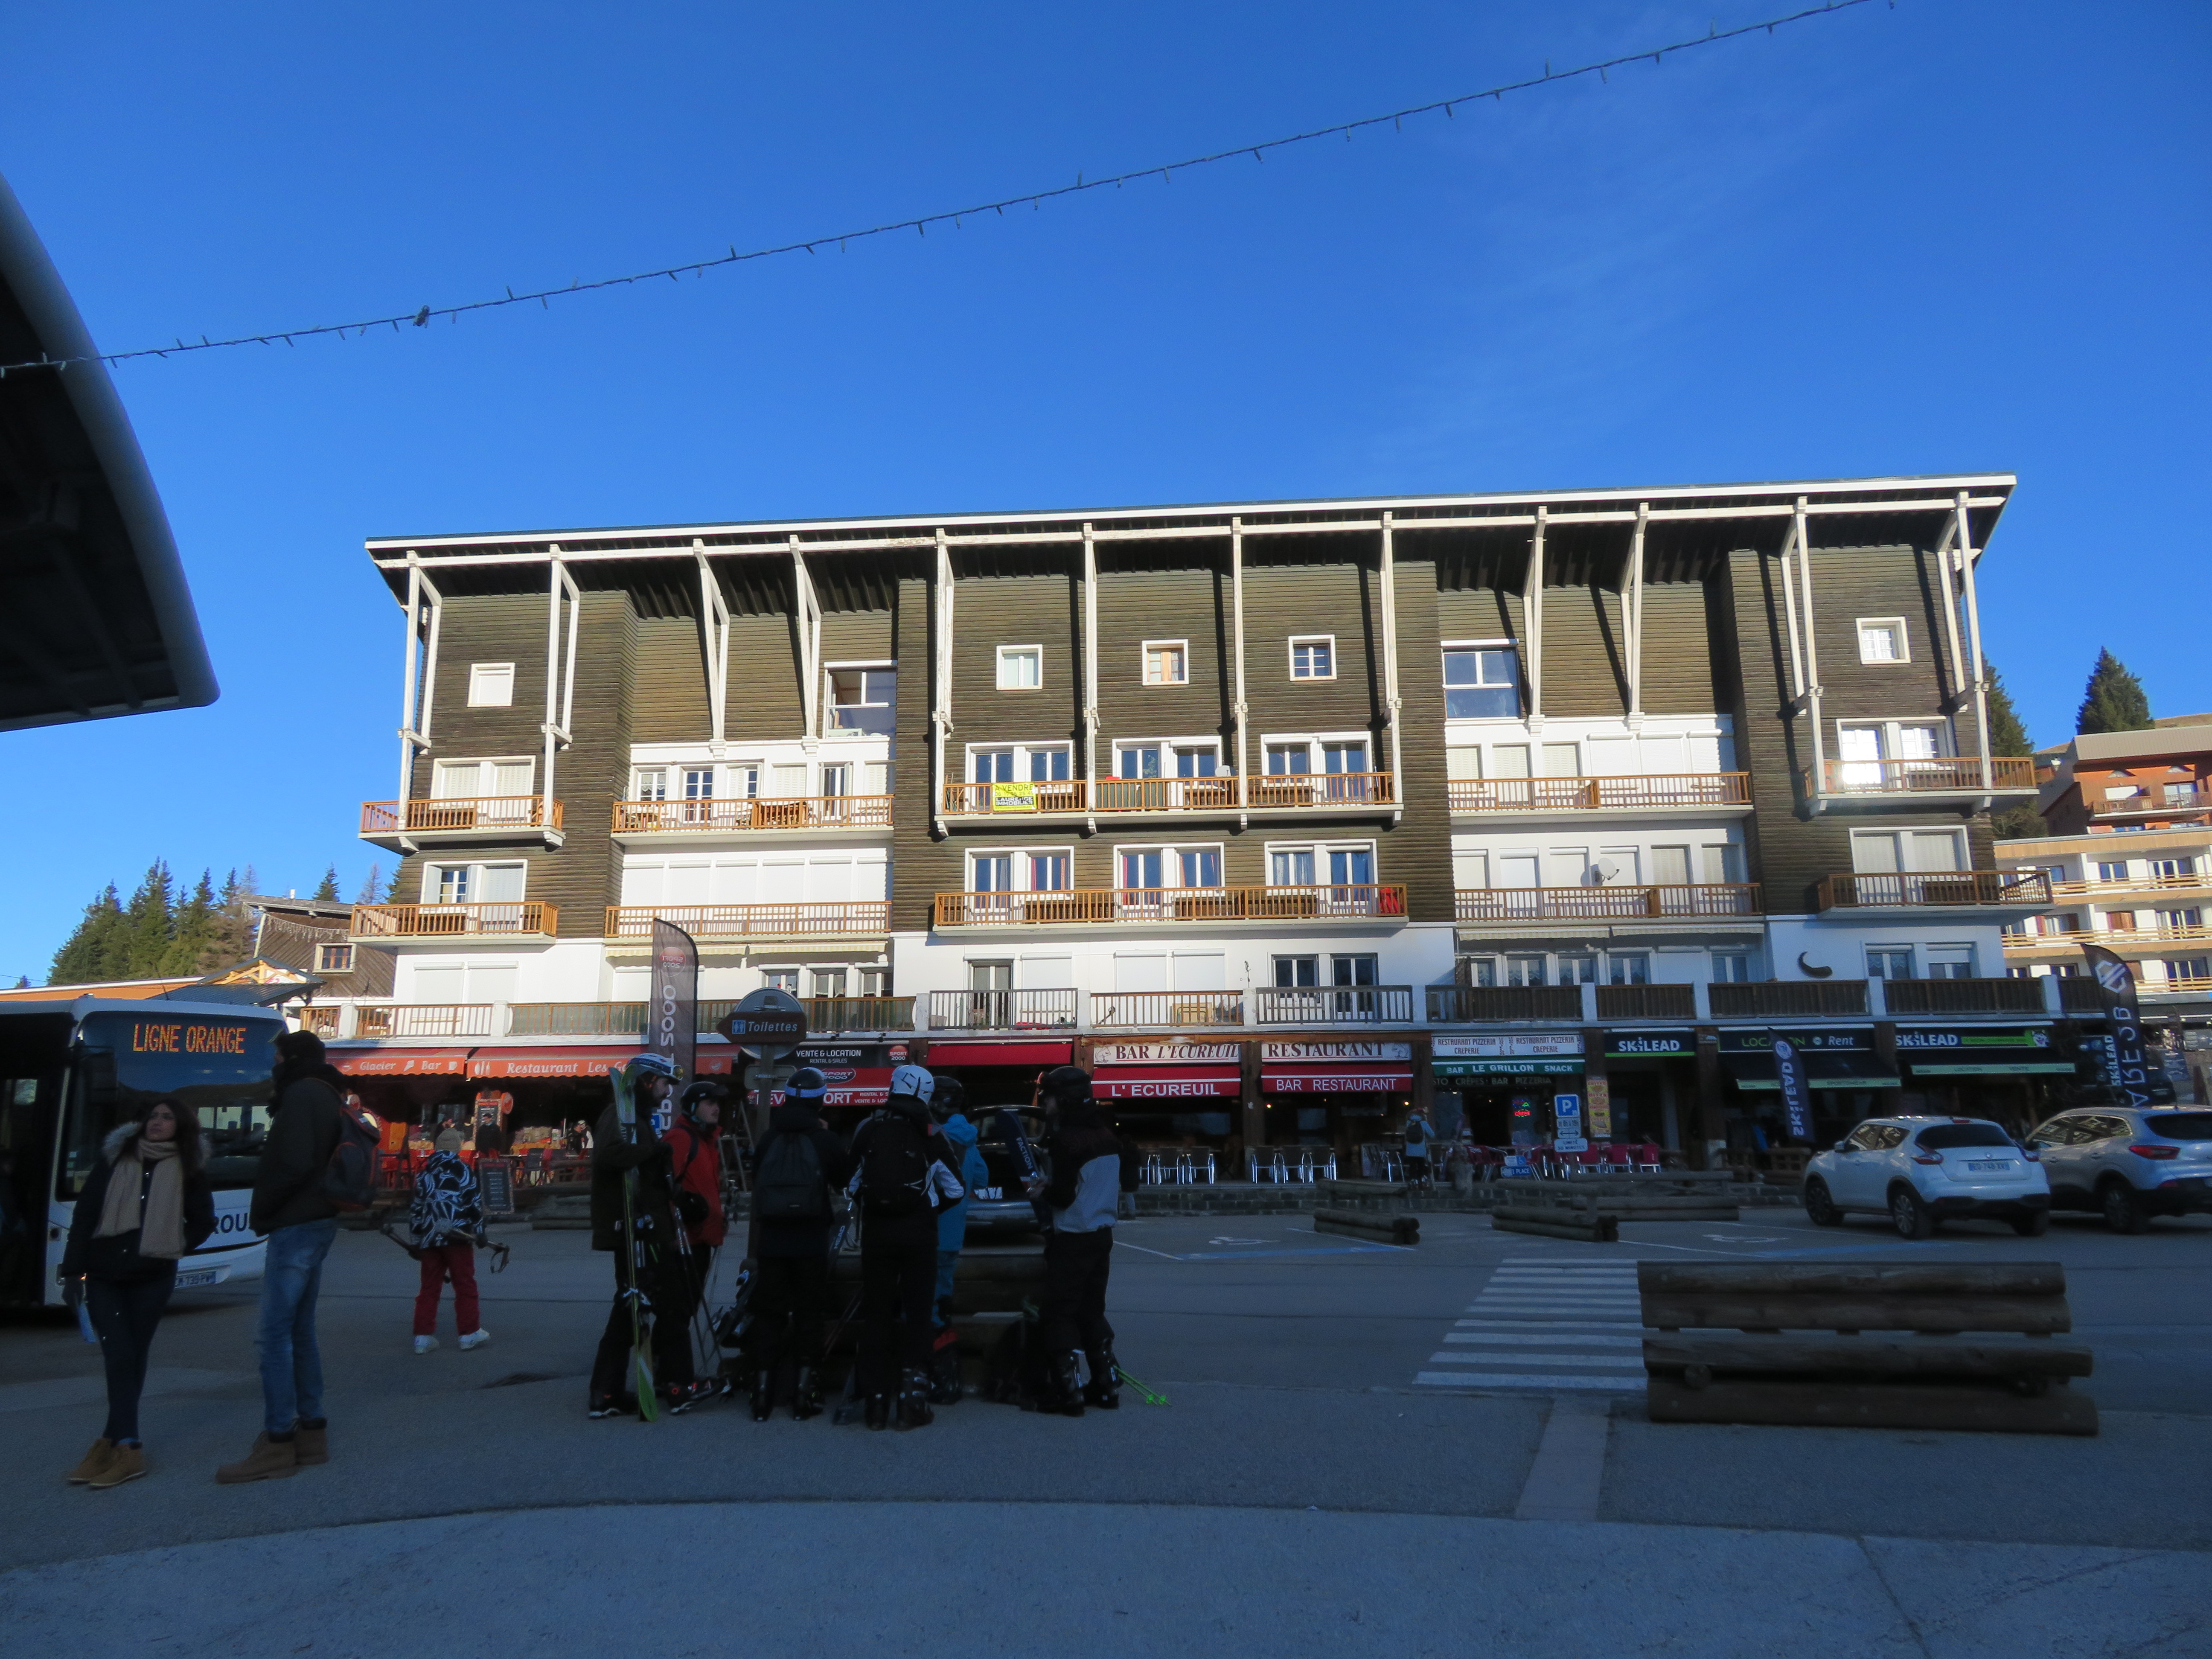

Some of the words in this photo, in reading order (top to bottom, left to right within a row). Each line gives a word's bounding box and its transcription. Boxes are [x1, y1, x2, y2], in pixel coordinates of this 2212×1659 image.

[748, 1022, 798, 1032] Toilettes
[132, 1023, 182, 1052] LIGNE
[186, 1025, 247, 1054] ORANGE
[1828, 1036, 1854, 1045] Rent
[1115, 1045, 1150, 1059] BAR
[1158, 1045, 1240, 1059] L'ECUREUIL
[1268, 1043, 1385, 1057] RESTAURANT
[359, 1061, 396, 1070] Glacier
[421, 1060, 442, 1070] Bar
[506, 1062, 579, 1074] Restaurant
[587, 1062, 608, 1073] Les
[1472, 1065, 1485, 1073] LE
[1132, 1083, 1220, 1096] ECUREUIL
[1276, 1079, 1302, 1091] BAR
[1313, 1078, 1397, 1091] RESTAURANT
[823, 1092, 853, 1104] ORT
[1562, 1099, 1572, 1113] P
[1016, 1137, 1033, 1170] FACTION
[834, 1225, 846, 1249] HEAD
